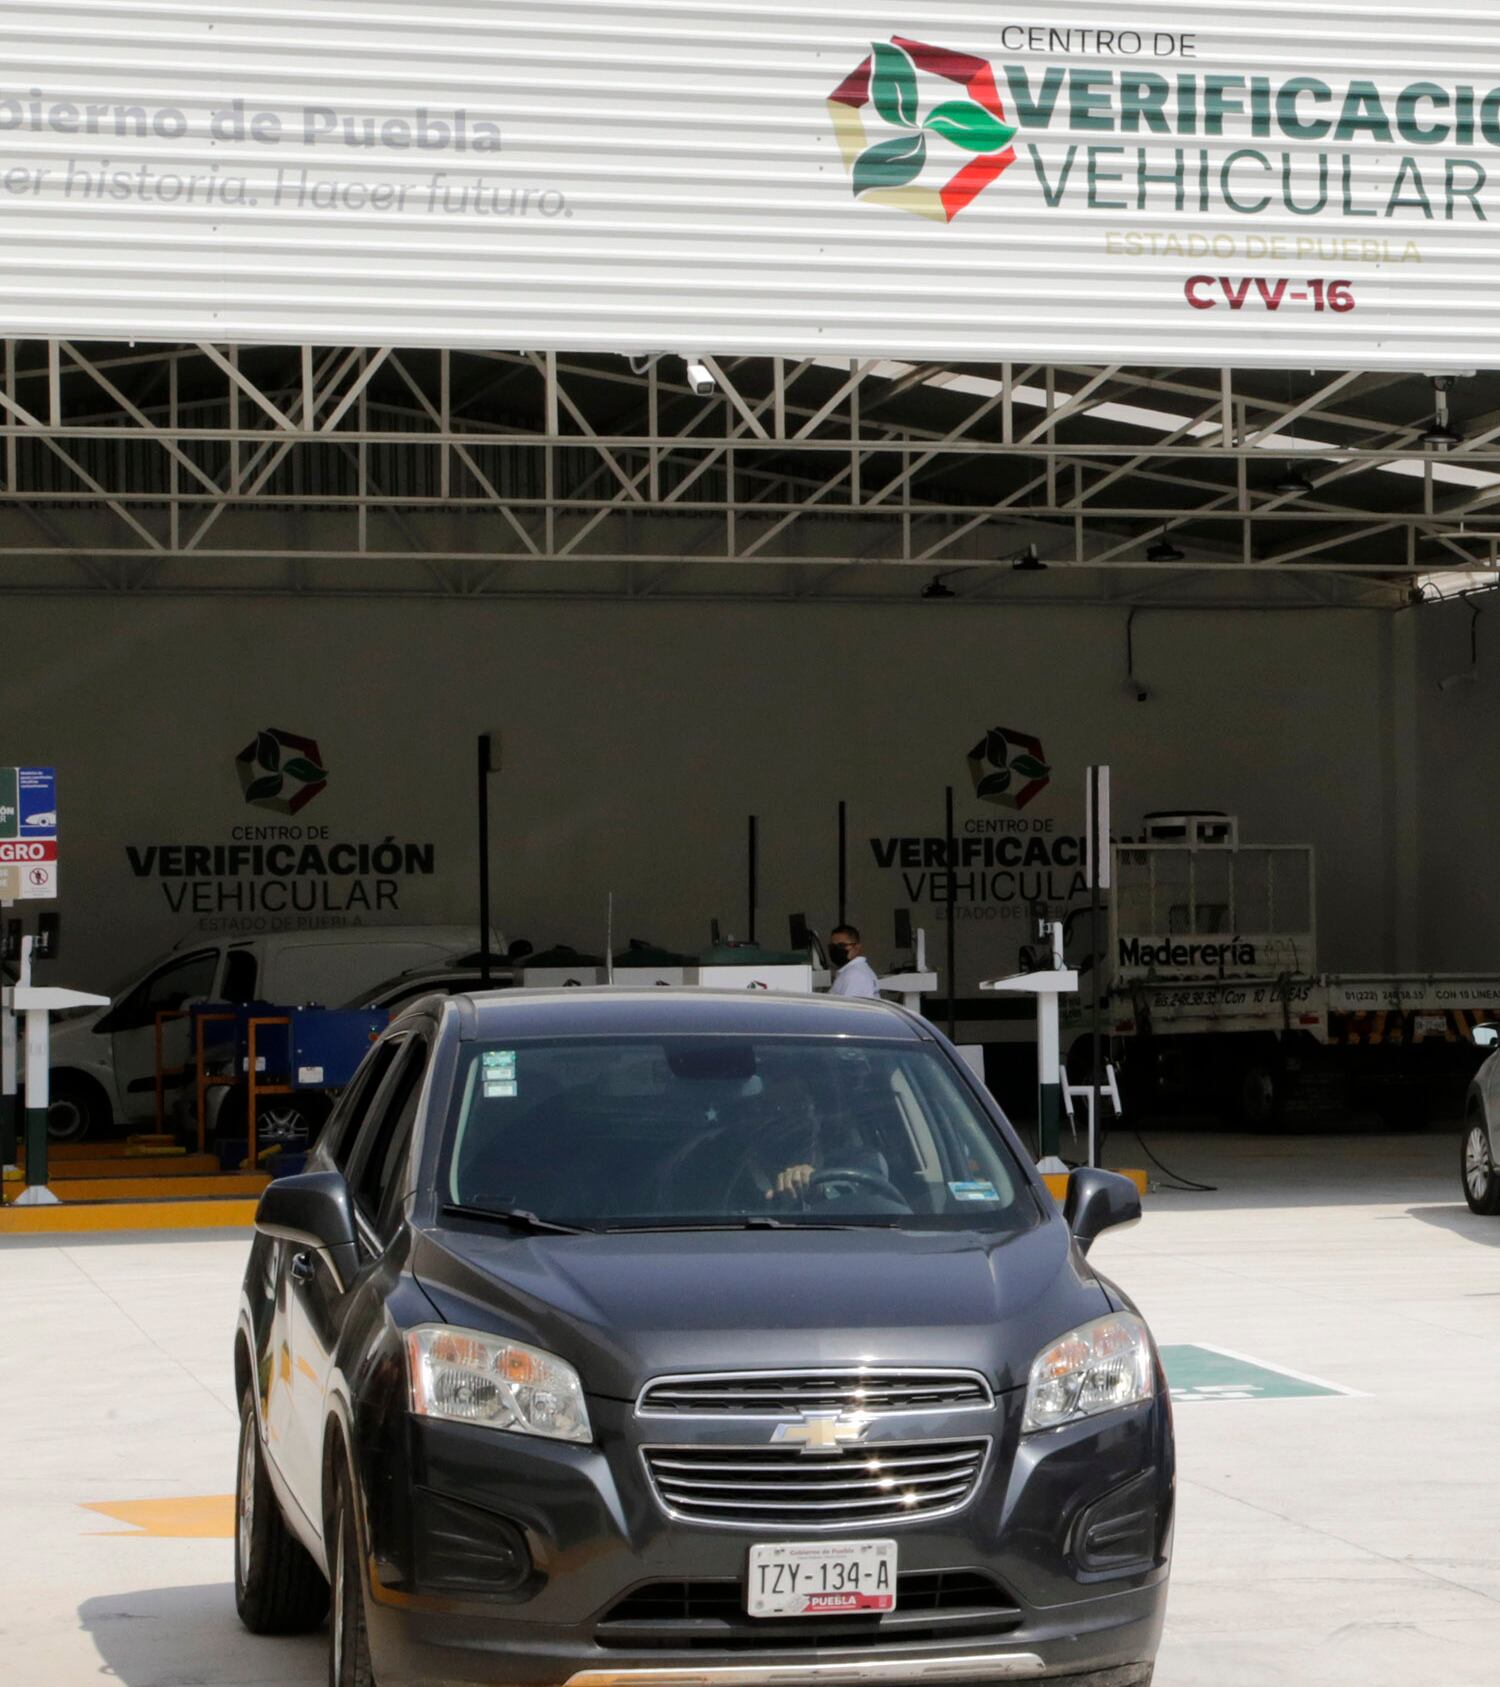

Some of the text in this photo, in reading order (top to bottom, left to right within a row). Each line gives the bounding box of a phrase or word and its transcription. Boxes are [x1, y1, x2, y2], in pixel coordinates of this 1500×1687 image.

[1001, 25, 1196, 58] CENTRO DE
[210, 98, 281, 144] de
[303, 106, 502, 153] Puebla
[65, 159, 258, 206] historia.
[274, 167, 416, 211] Hacer
[427, 172, 573, 218] futuro.
[1027, 144, 1487, 222] VEHICULAR
[1105, 232, 1421, 264] ESTADO DE PUEBLA
[1184, 275, 1355, 313] CVV-16
[232, 826, 329, 841] CENTRO DE
[965, 819, 1053, 832] CENTRO DE
[126, 836, 434, 876] VERIFICACIÓN
[162, 879, 399, 912] VEHICULAR
[903, 871, 1090, 901] VEHICULA
[199, 917, 266, 932] ESTADO
[1119, 936, 1255, 966] Maderería
[757, 1560, 889, 1594] TZY-134-A
[812, 1596, 857, 1606] PUEBLA
